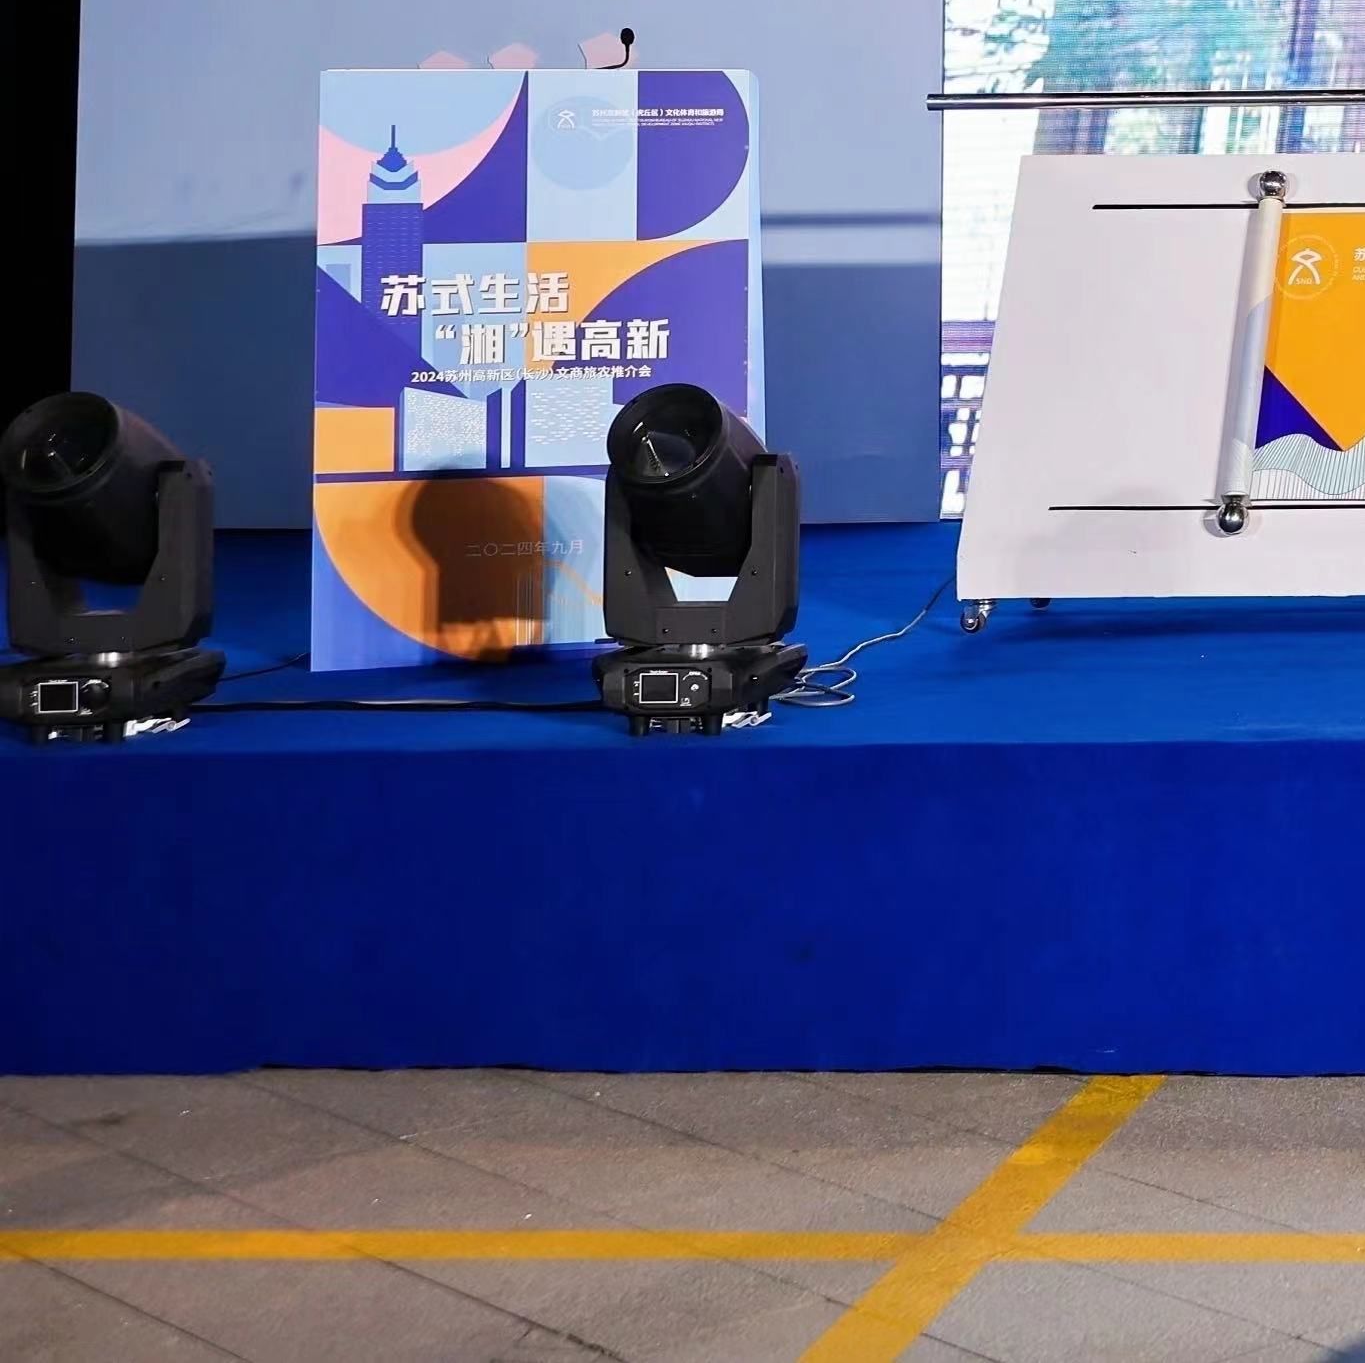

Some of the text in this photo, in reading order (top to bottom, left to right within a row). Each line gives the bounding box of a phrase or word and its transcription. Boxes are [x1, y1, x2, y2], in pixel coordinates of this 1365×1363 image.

[379, 272, 570, 317] 苏式生活
[435, 318, 670, 365] “湘”遇高新
